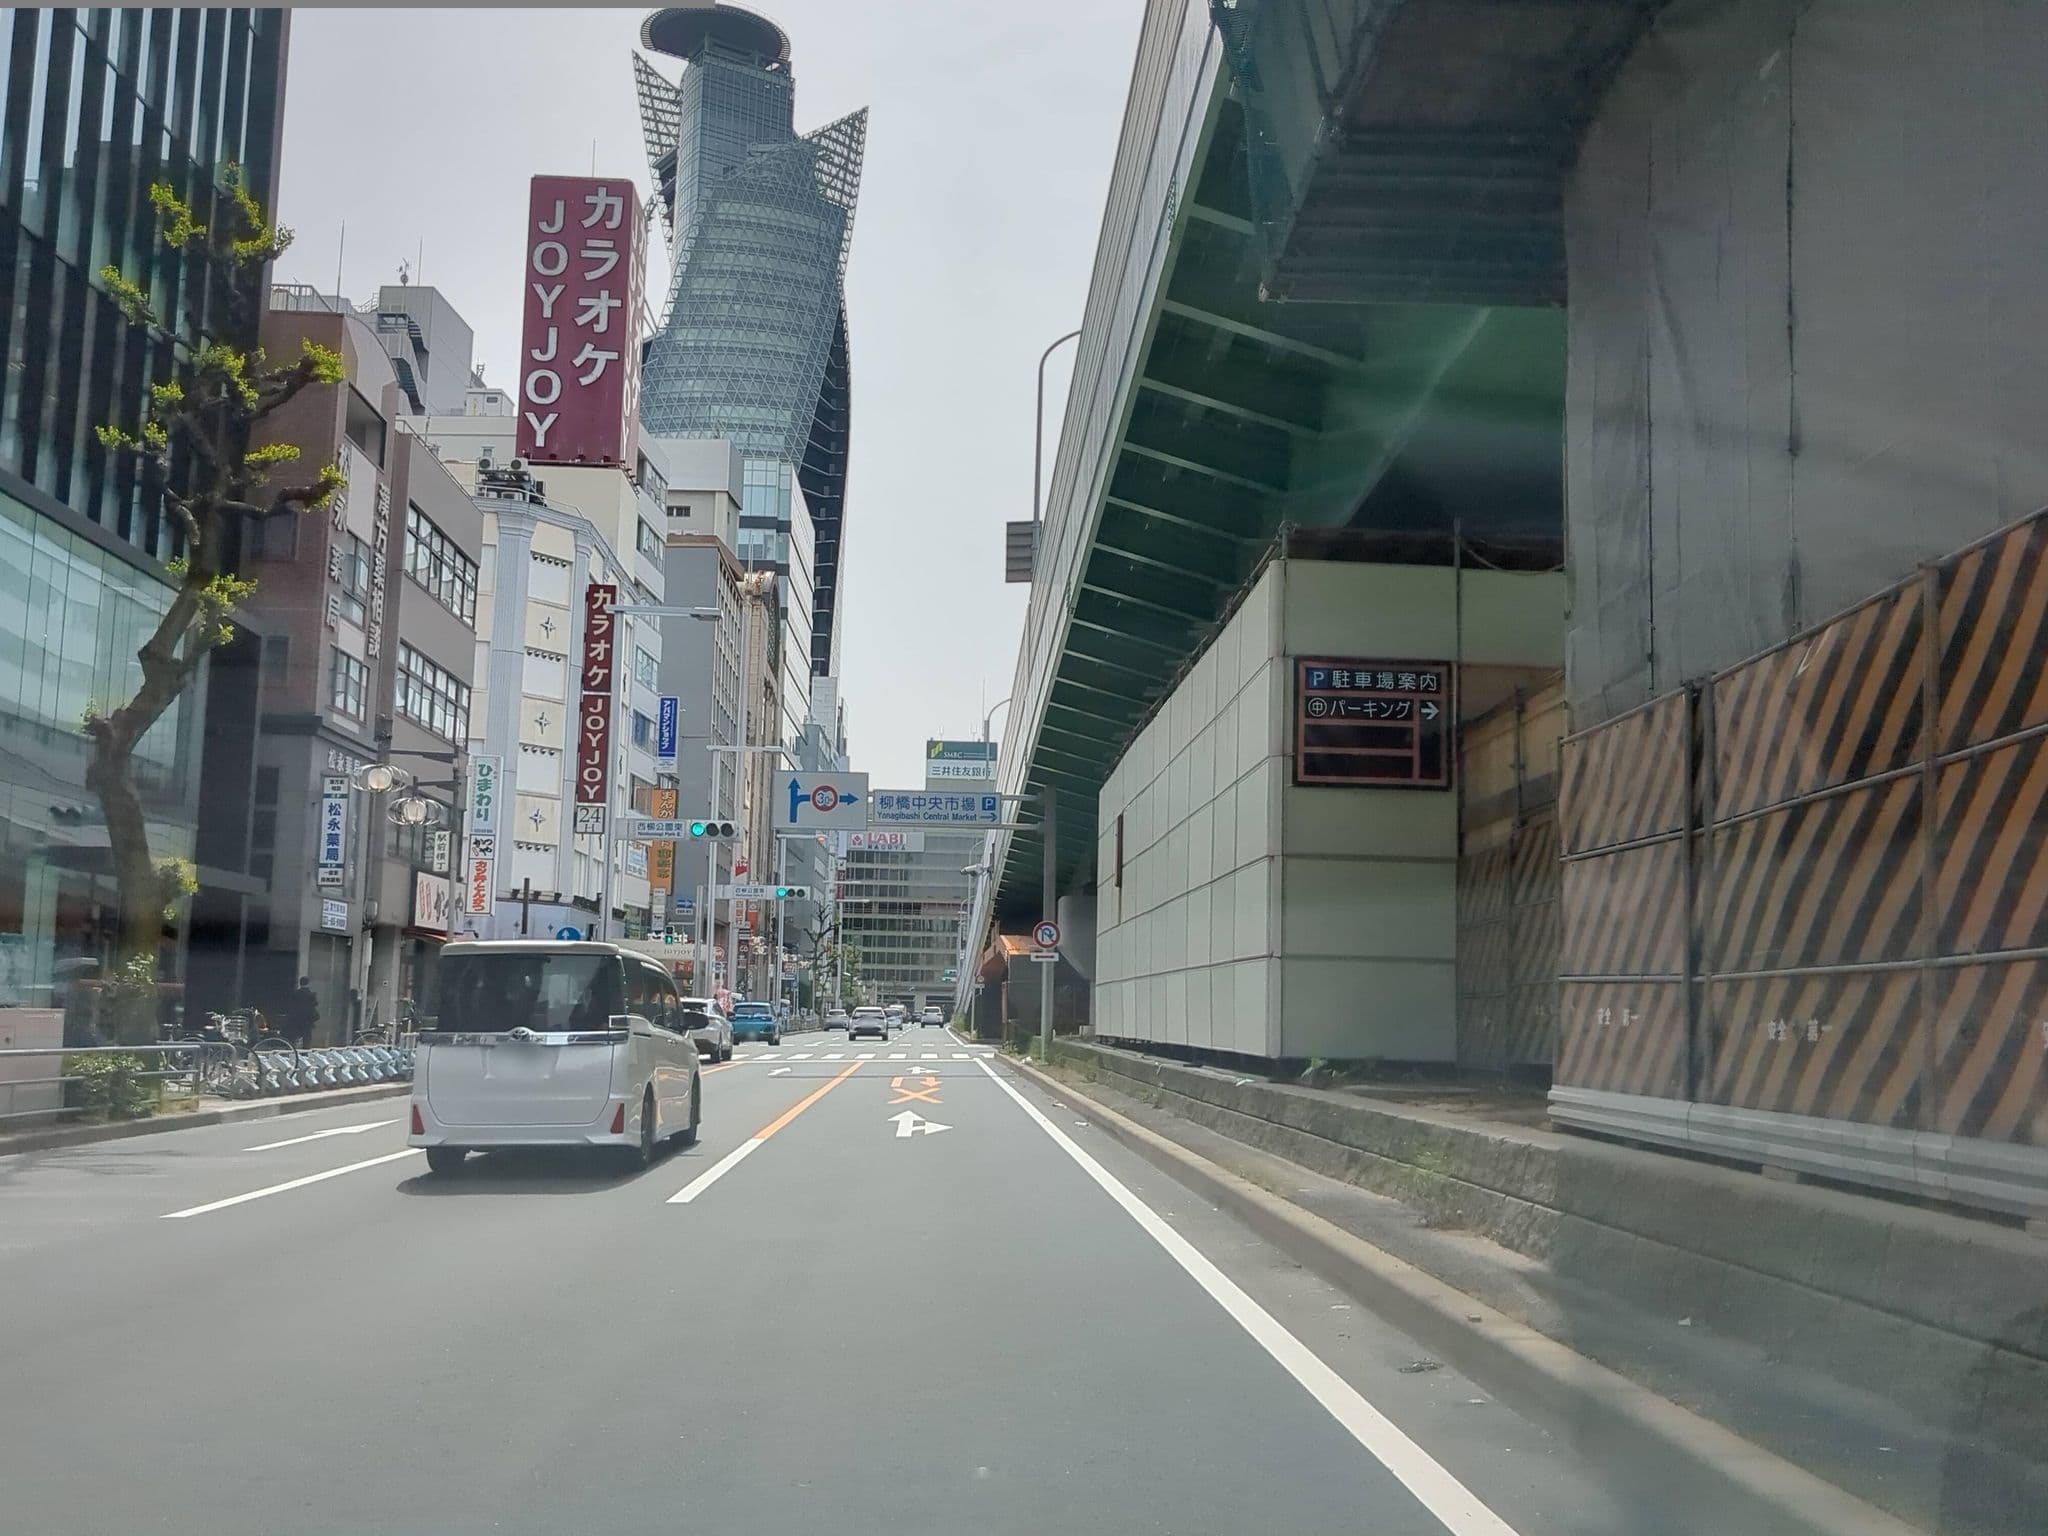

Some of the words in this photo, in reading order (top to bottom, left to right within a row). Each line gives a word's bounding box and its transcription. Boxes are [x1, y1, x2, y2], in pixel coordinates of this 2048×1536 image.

[572, 187, 624, 387] カラオケ
[524, 199, 569, 448] JOYJOY
[588, 588, 611, 687] カラオケ
[1332, 670, 1437, 691] 駐車場案内
[661, 700, 671, 749] アパマンショップ
[583, 698, 605, 800] JOYJOY
[943, 751, 963, 759] SMBC
[932, 766, 992, 777] 三井住友銀行
[476, 764, 493, 821] ひまわり
[879, 795, 976, 811] 柳橋中央市場
[325, 803, 342, 861] 松永薬局
[579, 807, 601, 823] 24
[877, 811, 920, 821] Yanagibashi
[923, 811, 949, 820] Central
[952, 813, 977, 821] Market
[867, 832, 904, 844] LABI
